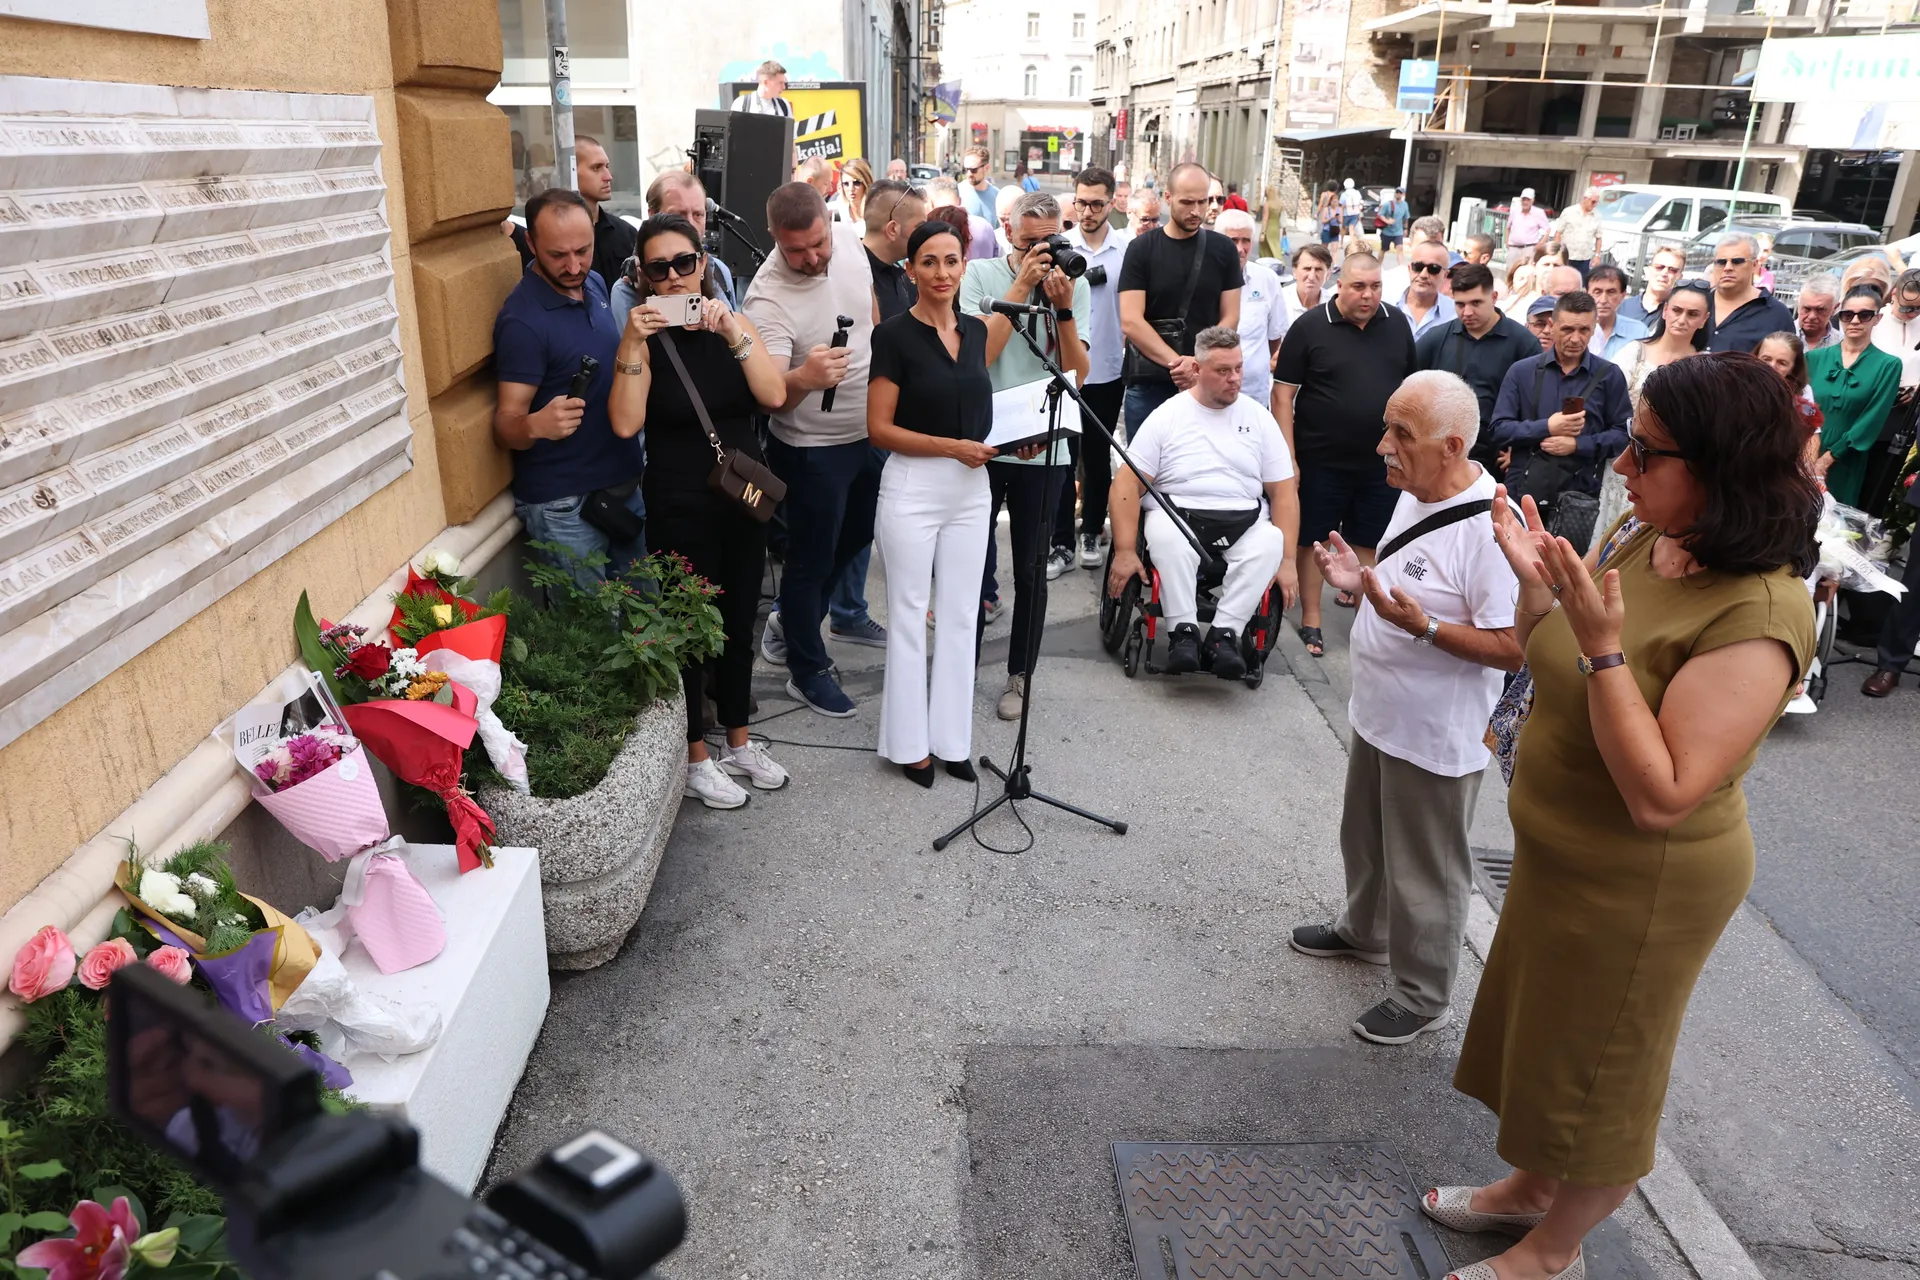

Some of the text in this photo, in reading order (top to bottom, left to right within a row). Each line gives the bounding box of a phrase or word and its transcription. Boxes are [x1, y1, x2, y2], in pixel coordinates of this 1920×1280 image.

[1410, 62, 1430, 86] P
[796, 136, 842, 160] kcija!
[742, 481, 763, 508] M
[1402, 561, 1428, 582] MORE
[1414, 555, 1427, 567] LIVE
